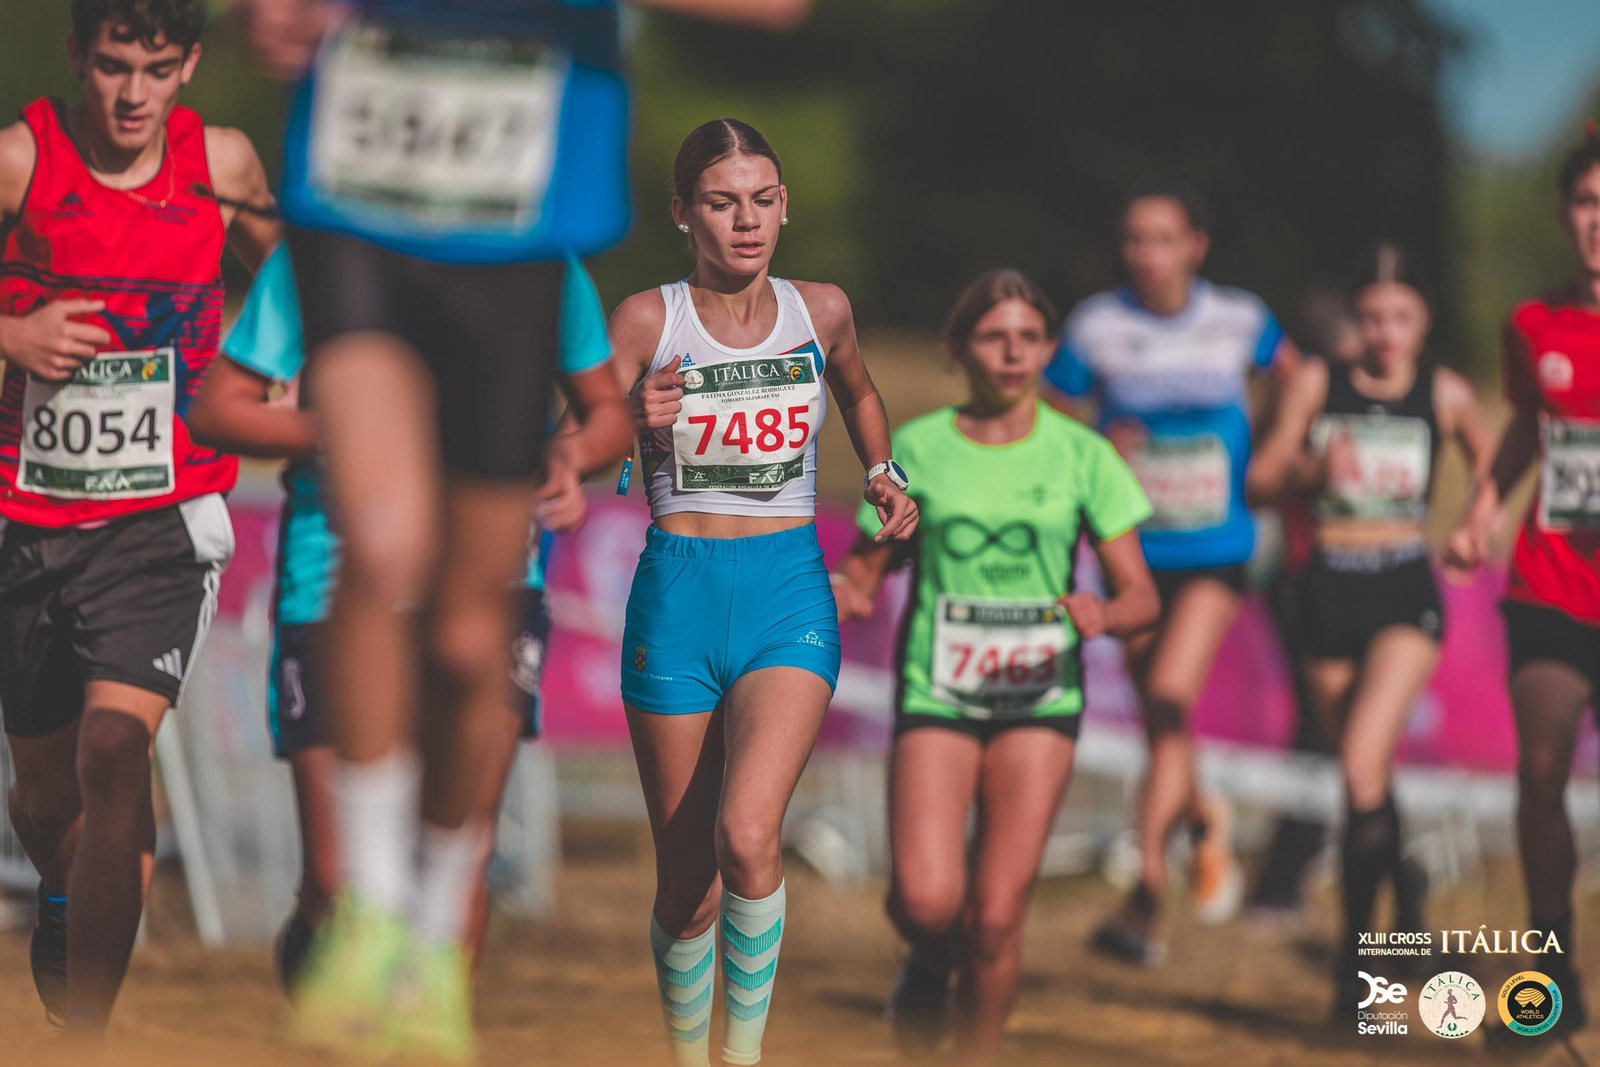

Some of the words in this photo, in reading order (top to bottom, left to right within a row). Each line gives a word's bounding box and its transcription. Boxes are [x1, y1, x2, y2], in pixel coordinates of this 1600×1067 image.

[713, 363, 780, 383] ITÁLICA
[721, 396, 745, 404] TOMARES
[33, 406, 160, 456] 8054
[688, 405, 809, 455] 7485
[797, 637, 825, 648] AIRE
[946, 641, 1057, 686] 7463
